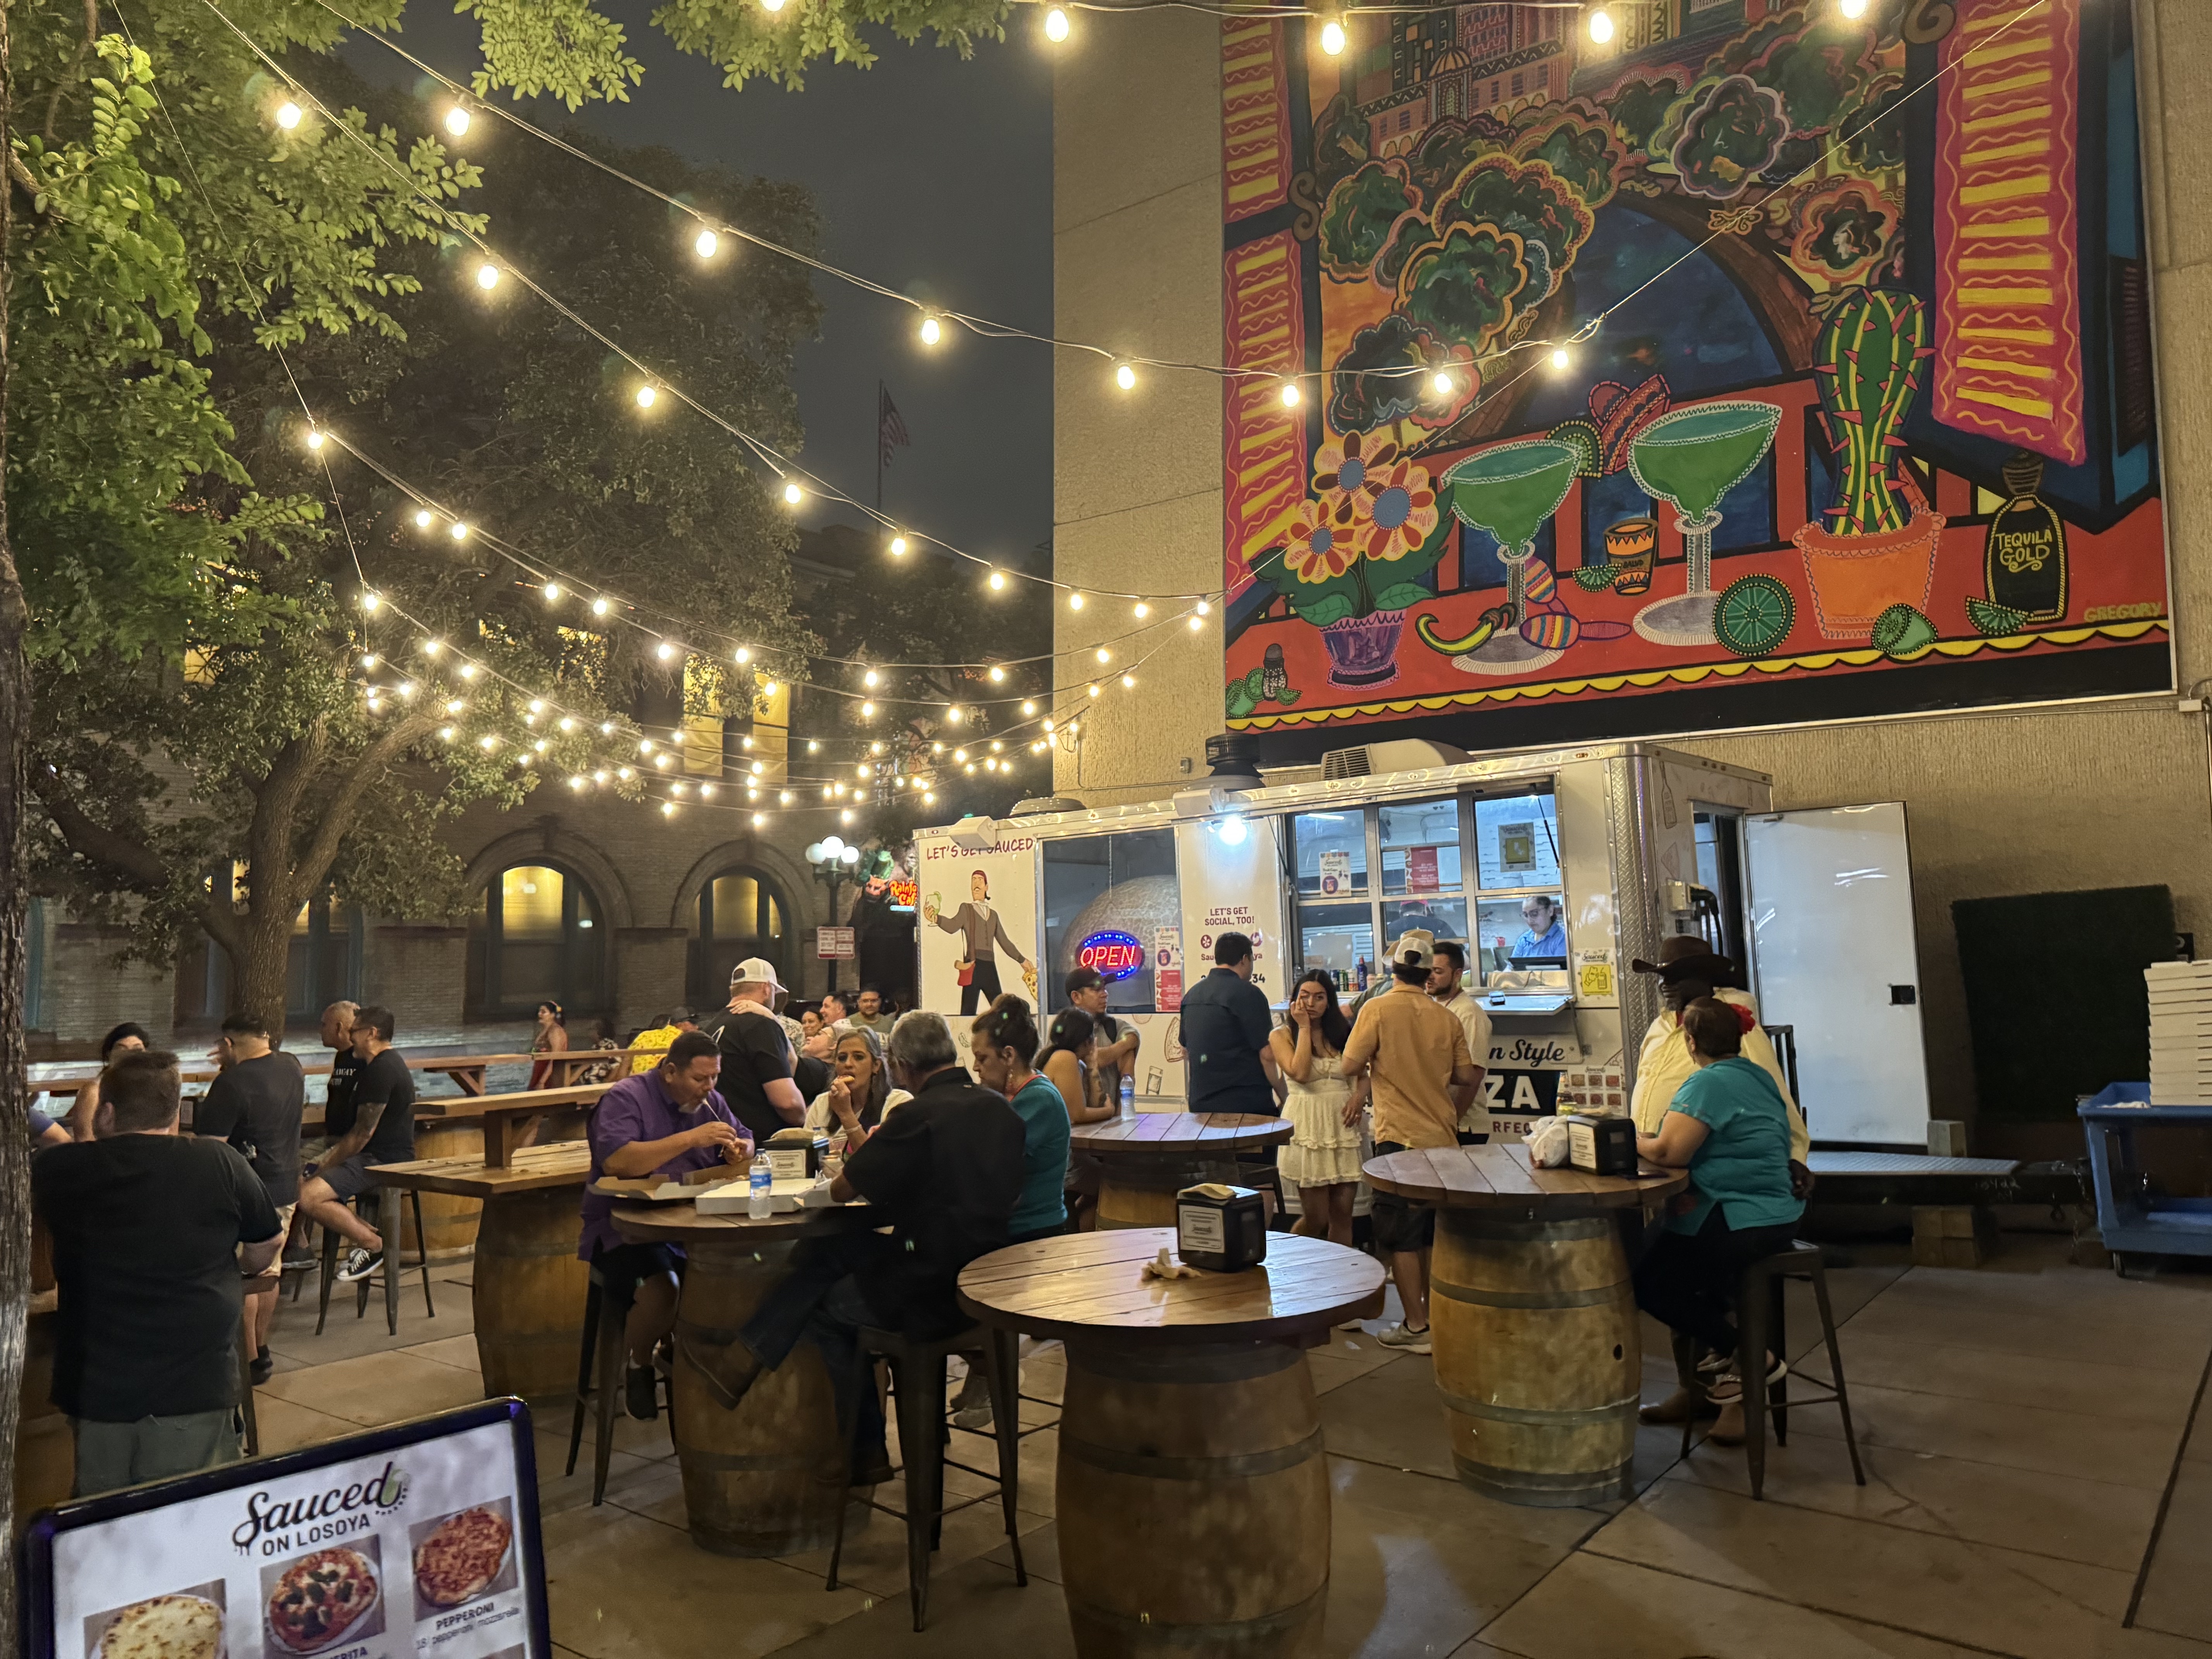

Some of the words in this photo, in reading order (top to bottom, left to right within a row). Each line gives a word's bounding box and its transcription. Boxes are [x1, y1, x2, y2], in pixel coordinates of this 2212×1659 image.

[1995, 529, 2052, 550] TEQUILA
[2000, 544, 2050, 565] GOLD
[2084, 601, 2162, 623] GREGORY
[927, 845, 958, 860] LET'S
[898, 892, 917, 906] Caf
[1205, 917, 1235, 926] SOCIAL,
[1236, 915, 1254, 924] TOO!
[1210, 907, 1231, 916] LET'S
[1233, 907, 1248, 915] GET
[1080, 945, 1135, 967] OPEN
[1509, 1039, 1565, 1068] Style
[232, 1462, 402, 1547] Sauced
[263, 1535, 289, 1556] ON
[297, 1513, 371, 1546] LOSOYA
[436, 1602, 495, 1630] PEPPERONI
